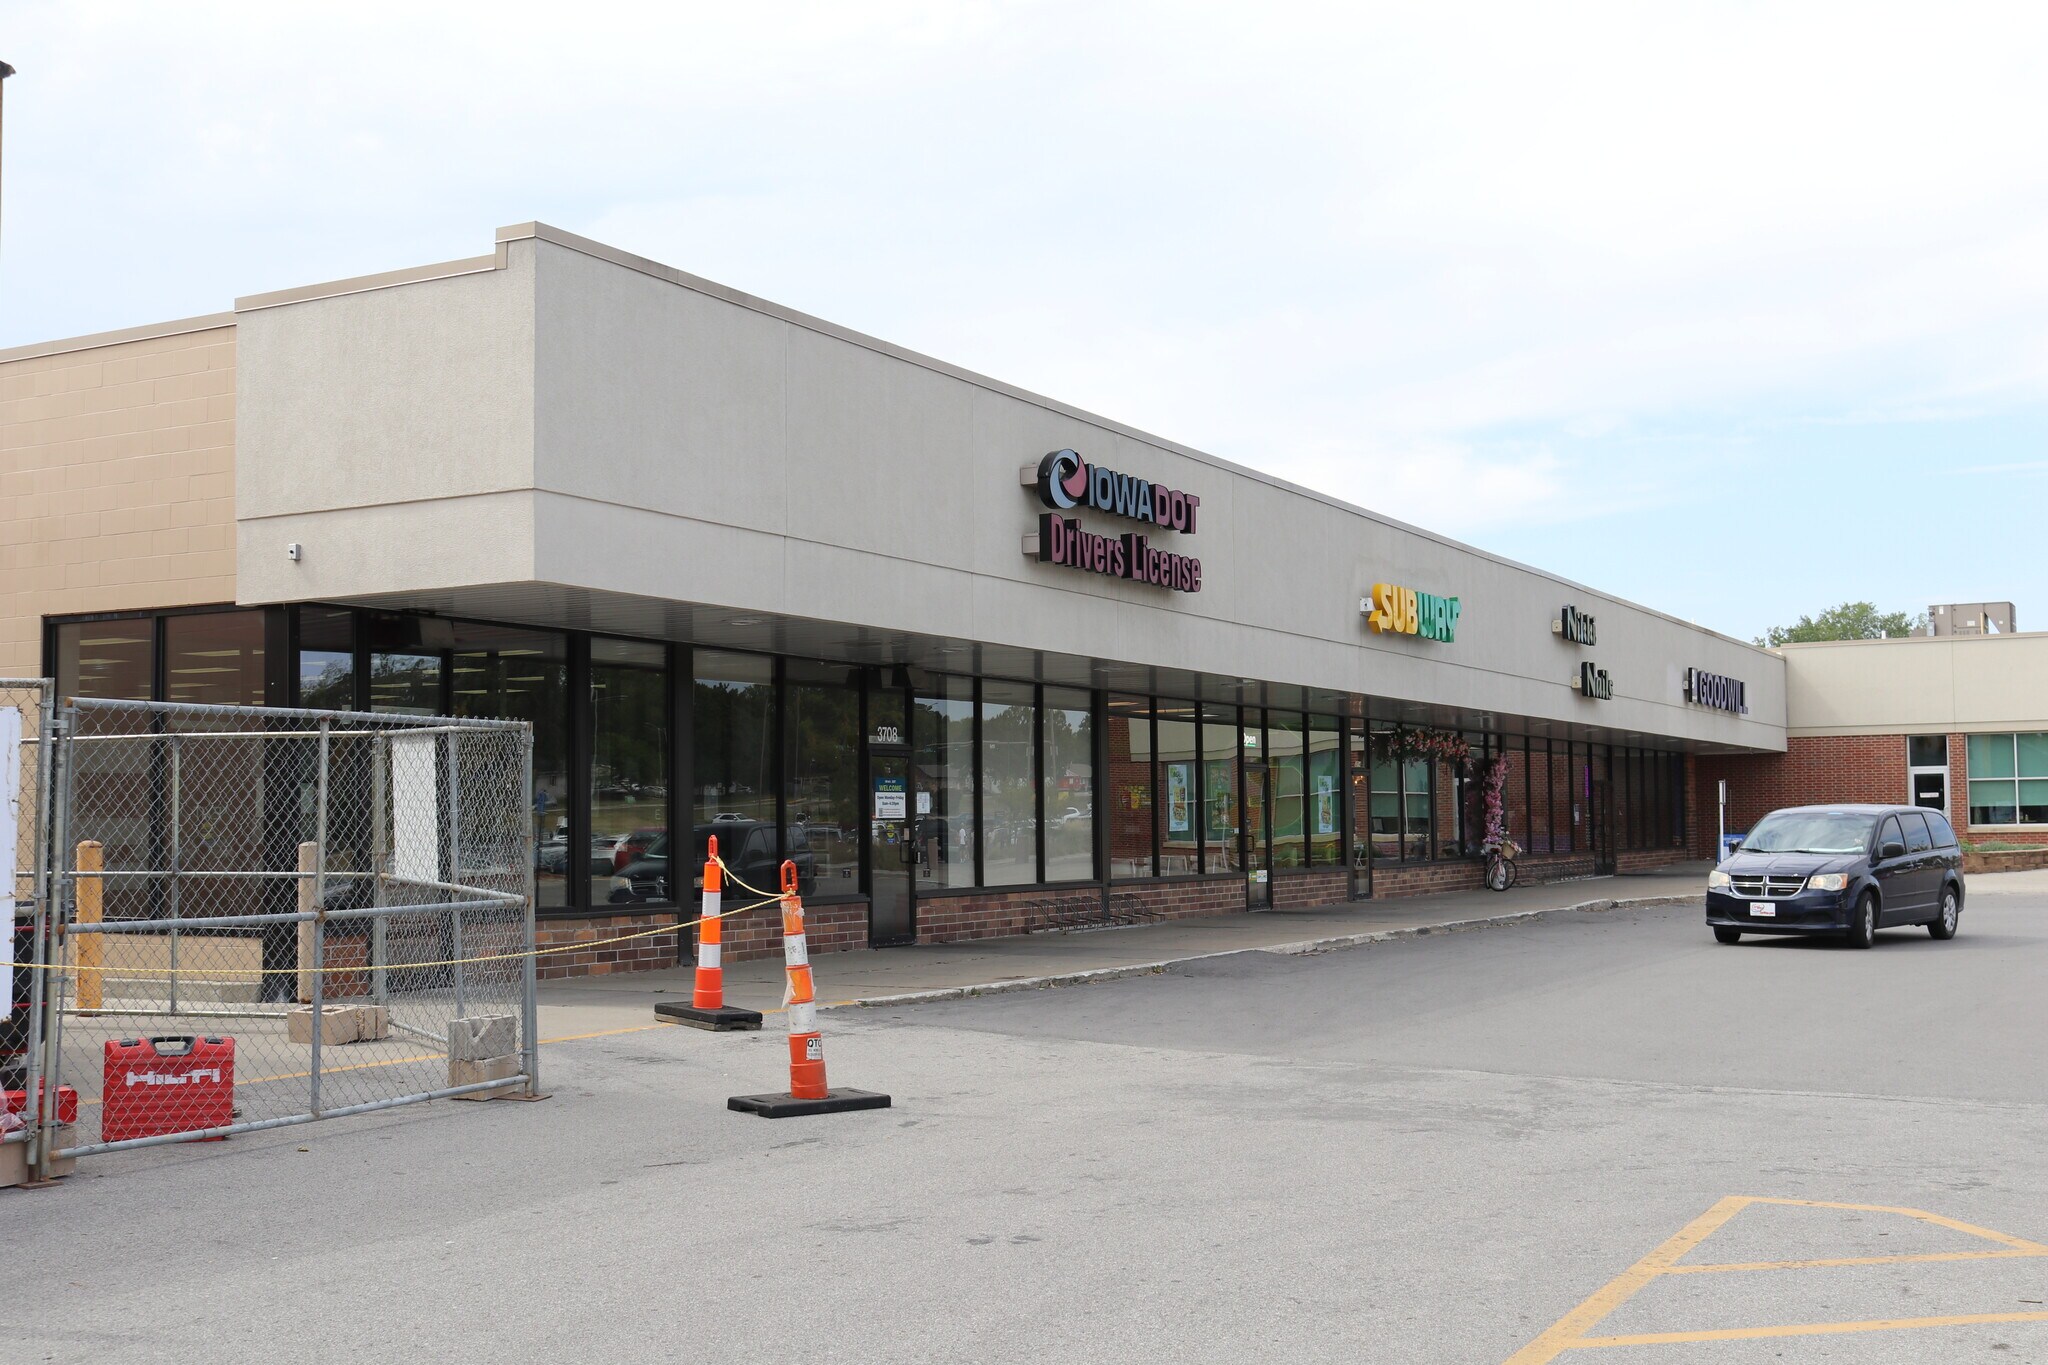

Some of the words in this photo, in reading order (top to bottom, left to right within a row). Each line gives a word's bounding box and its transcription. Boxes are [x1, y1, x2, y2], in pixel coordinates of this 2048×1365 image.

[1049, 513, 1124, 577] Drivers
[1129, 533, 1202, 592] License
[1370, 583, 1462, 643] SUBWAY
[1584, 661, 1613, 700] Nails
[1698, 670, 1748, 714] GOODWILL
[877, 726, 898, 742] 3708
[126, 1068, 221, 1087] HILTI
